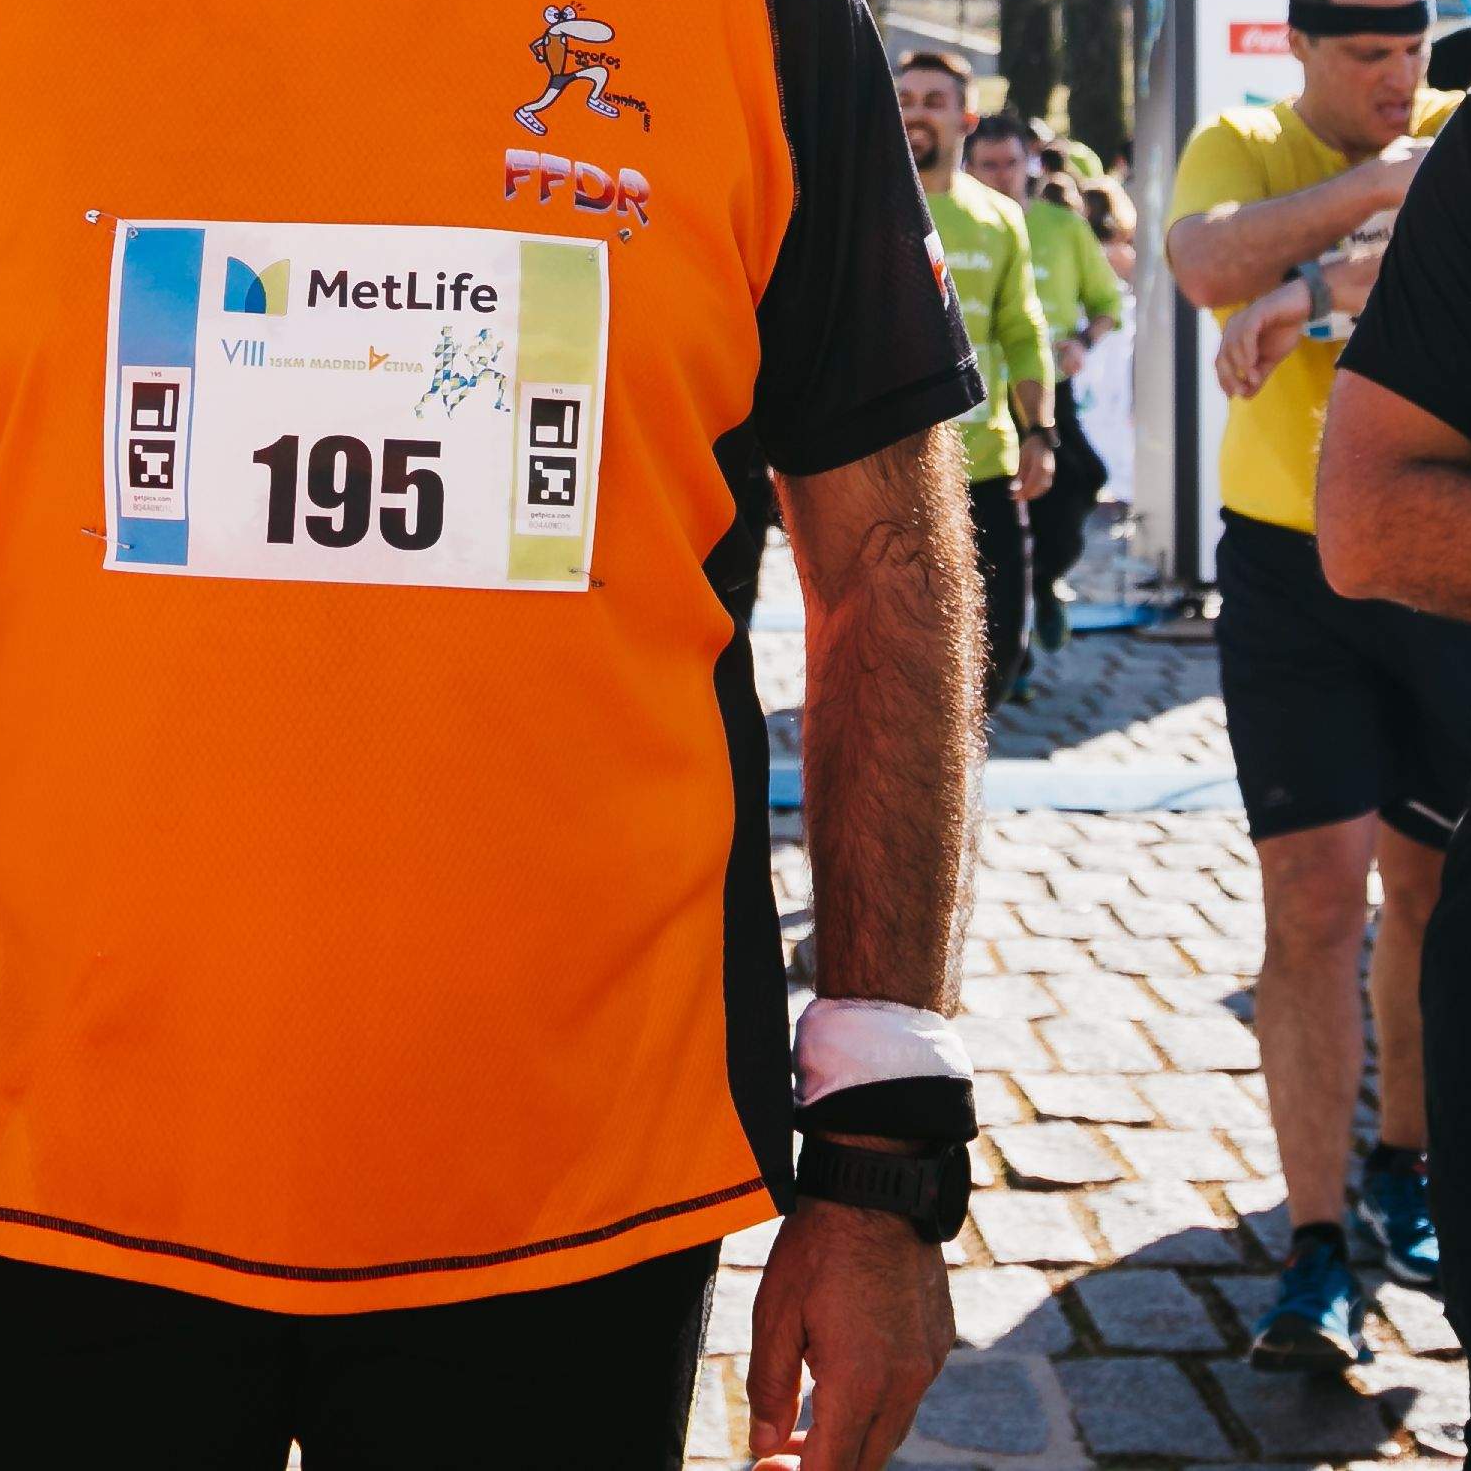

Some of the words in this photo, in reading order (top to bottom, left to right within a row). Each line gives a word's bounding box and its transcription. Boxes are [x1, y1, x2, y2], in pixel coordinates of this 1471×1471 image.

[504, 147, 651, 227] FFDR
[307, 269, 498, 313] MetLife
[221, 338, 265, 367] VIII
[269, 357, 305, 368] 15KM
[309, 359, 366, 371] MADRID
[252, 434, 444, 551] 195
